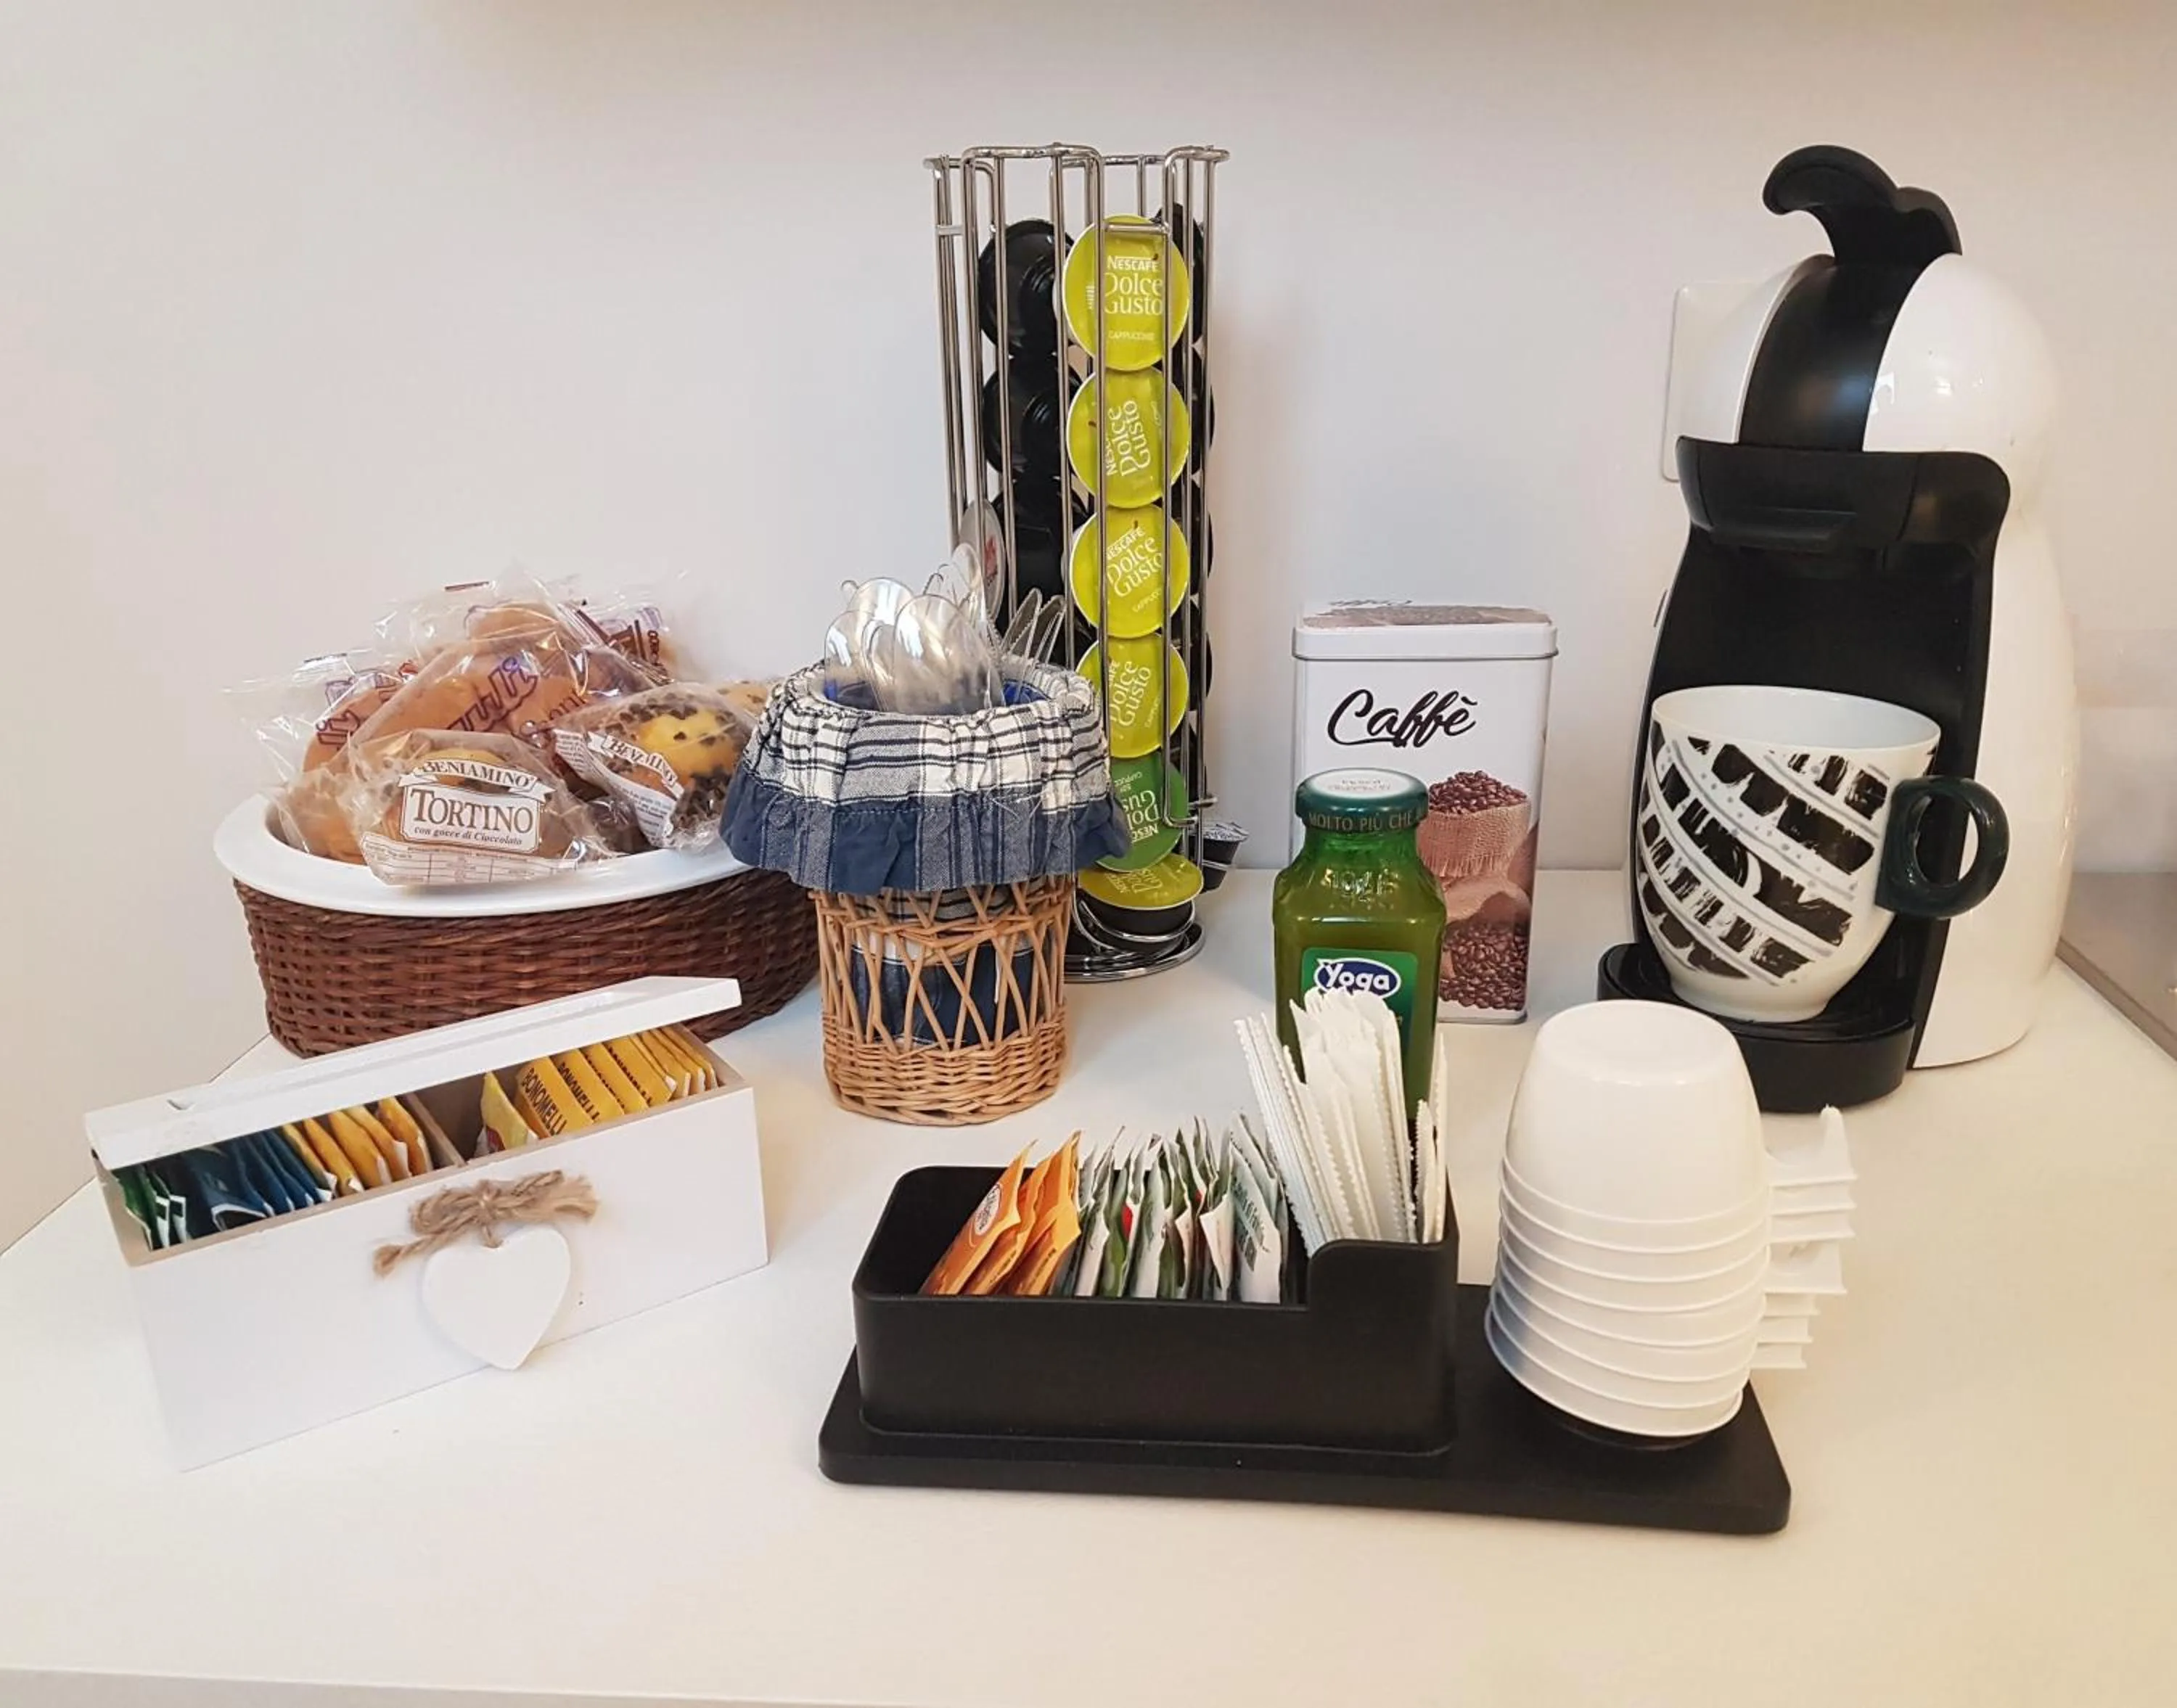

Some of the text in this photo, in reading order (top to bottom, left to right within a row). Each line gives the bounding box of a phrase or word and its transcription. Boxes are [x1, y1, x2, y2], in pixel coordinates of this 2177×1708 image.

[1104, 272, 1163, 297] Dolce
[1104, 295, 1163, 316] Gusto
[1107, 406, 1137, 476] Dolce
[1123, 401, 1151, 468] Gusto
[1107, 537, 1157, 585] Dolce
[1114, 553, 1162, 597] Gusto
[1109, 661, 1139, 722] Dolce
[1118, 667, 1151, 726] Gusto
[1327, 689, 1477, 748] Caffè
[411, 789, 533, 834] TORTINO
[1123, 790, 1155, 812] Gus
[1128, 803, 1161, 831] Dol
[414, 826, 522, 845] con gocce di Cioccolato
[1132, 824, 1159, 843] NESC
[1324, 963, 1390, 992] Yoga
[522, 1067, 567, 1136] BONOMELLI
